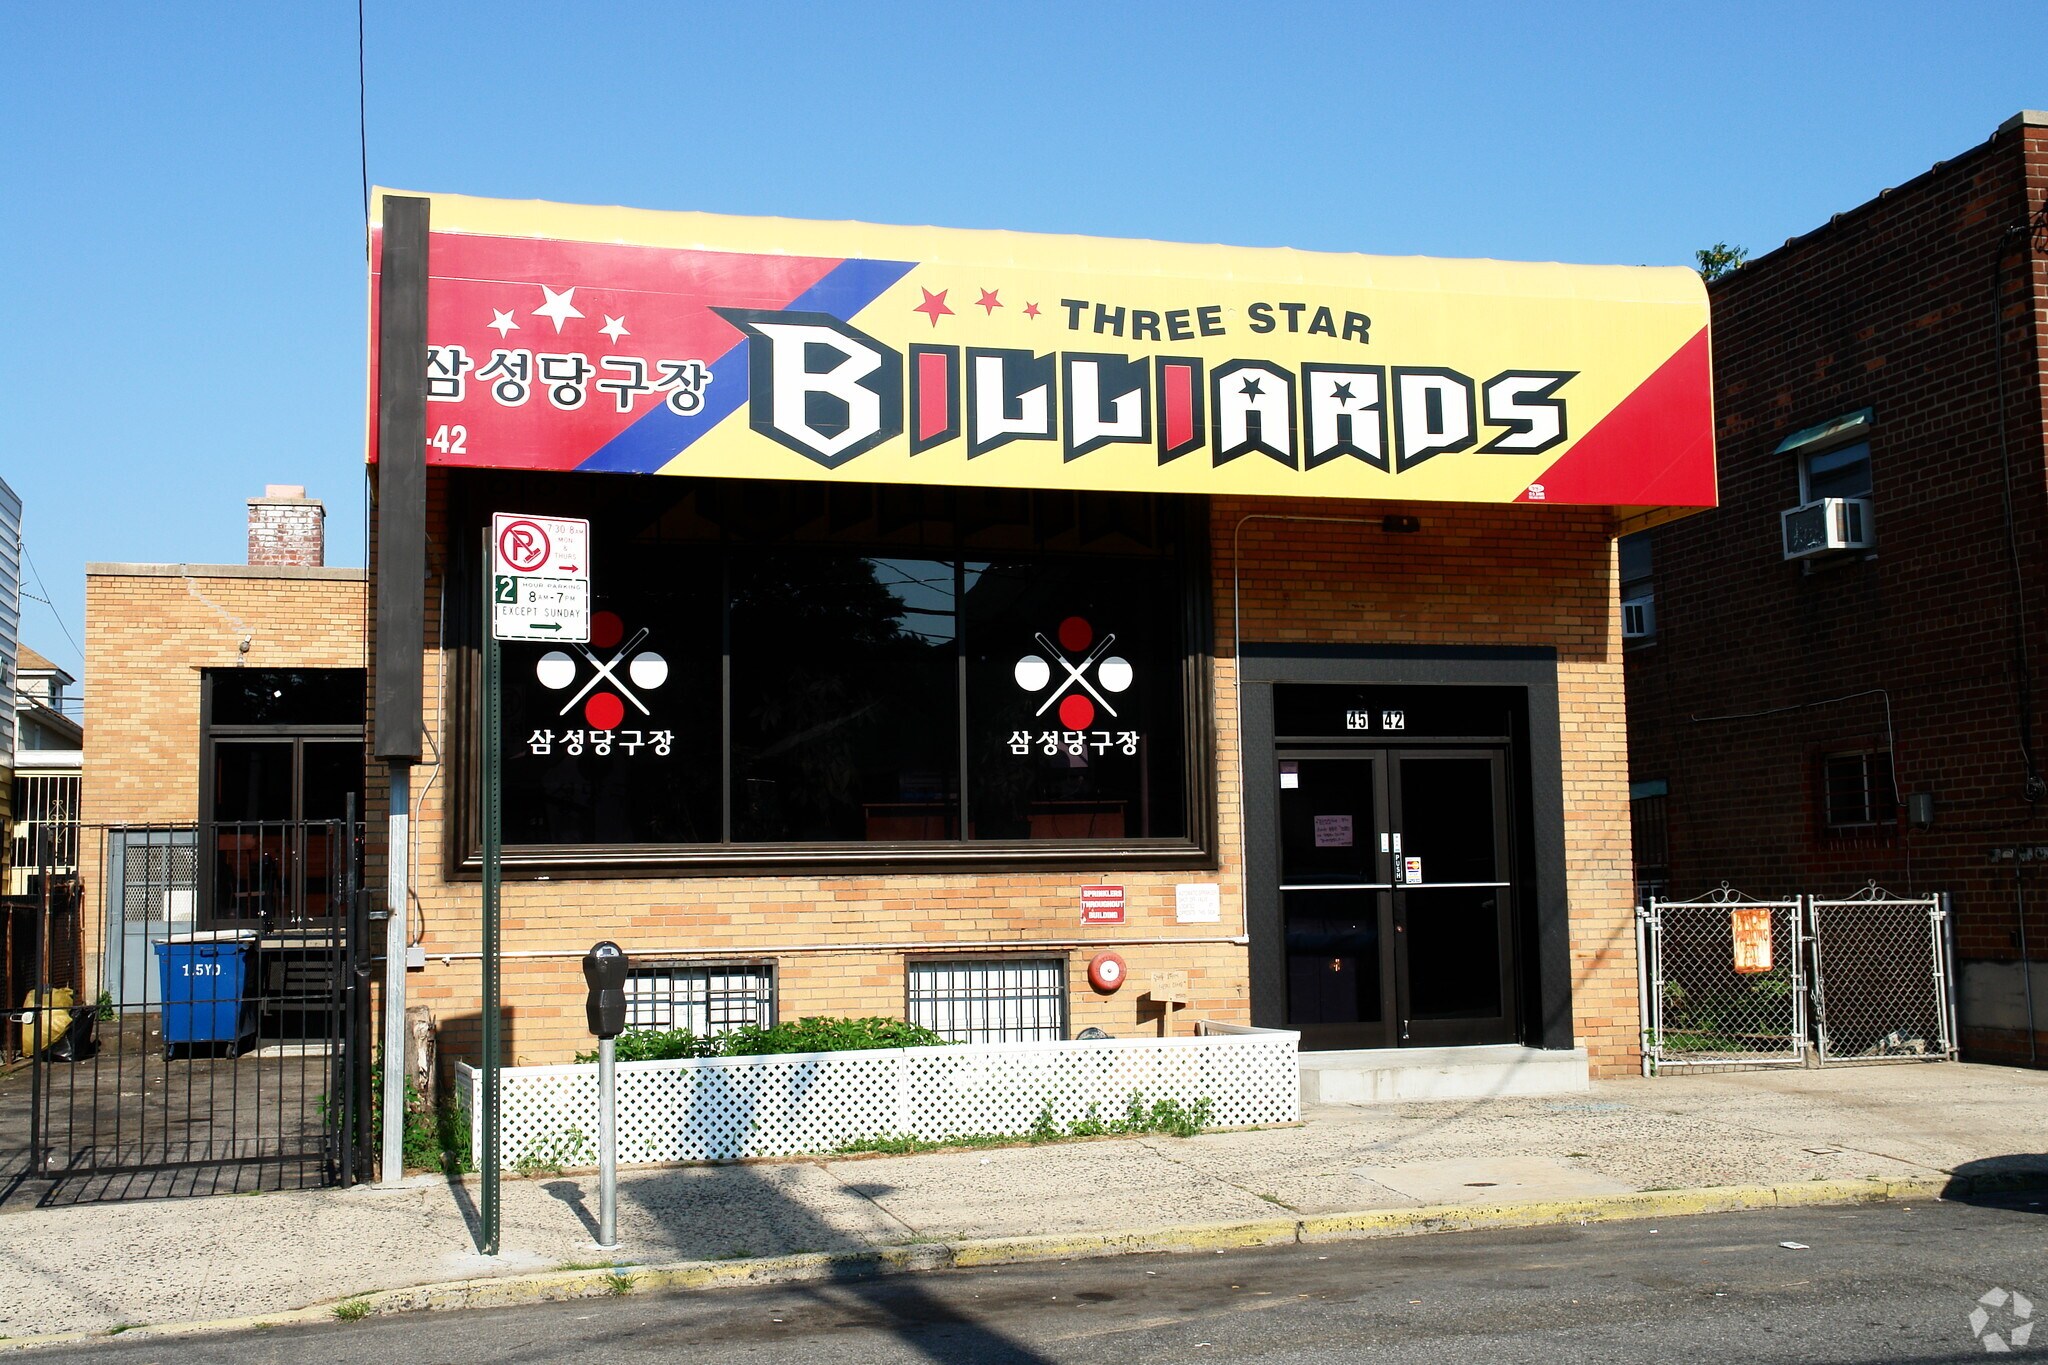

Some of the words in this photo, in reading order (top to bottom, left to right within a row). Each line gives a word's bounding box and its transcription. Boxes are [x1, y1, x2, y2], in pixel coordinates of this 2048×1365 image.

[1061, 298, 1226, 342] THREE
[1247, 302, 1372, 345] STAR
[427, 346, 713, 416] 삼성당구장
[707, 306, 1581, 474] BILLIARDS
[499, 577, 514, 602] 2
[502, 606, 538, 616] EXCEPT
[544, 607, 581, 618] SUNDAY
[1348, 710, 1367, 729] 45
[1384, 710, 1403, 729] 42
[526, 729, 675, 756] 삼성당구장
[1006, 730, 1141, 756] 삼성당구장
